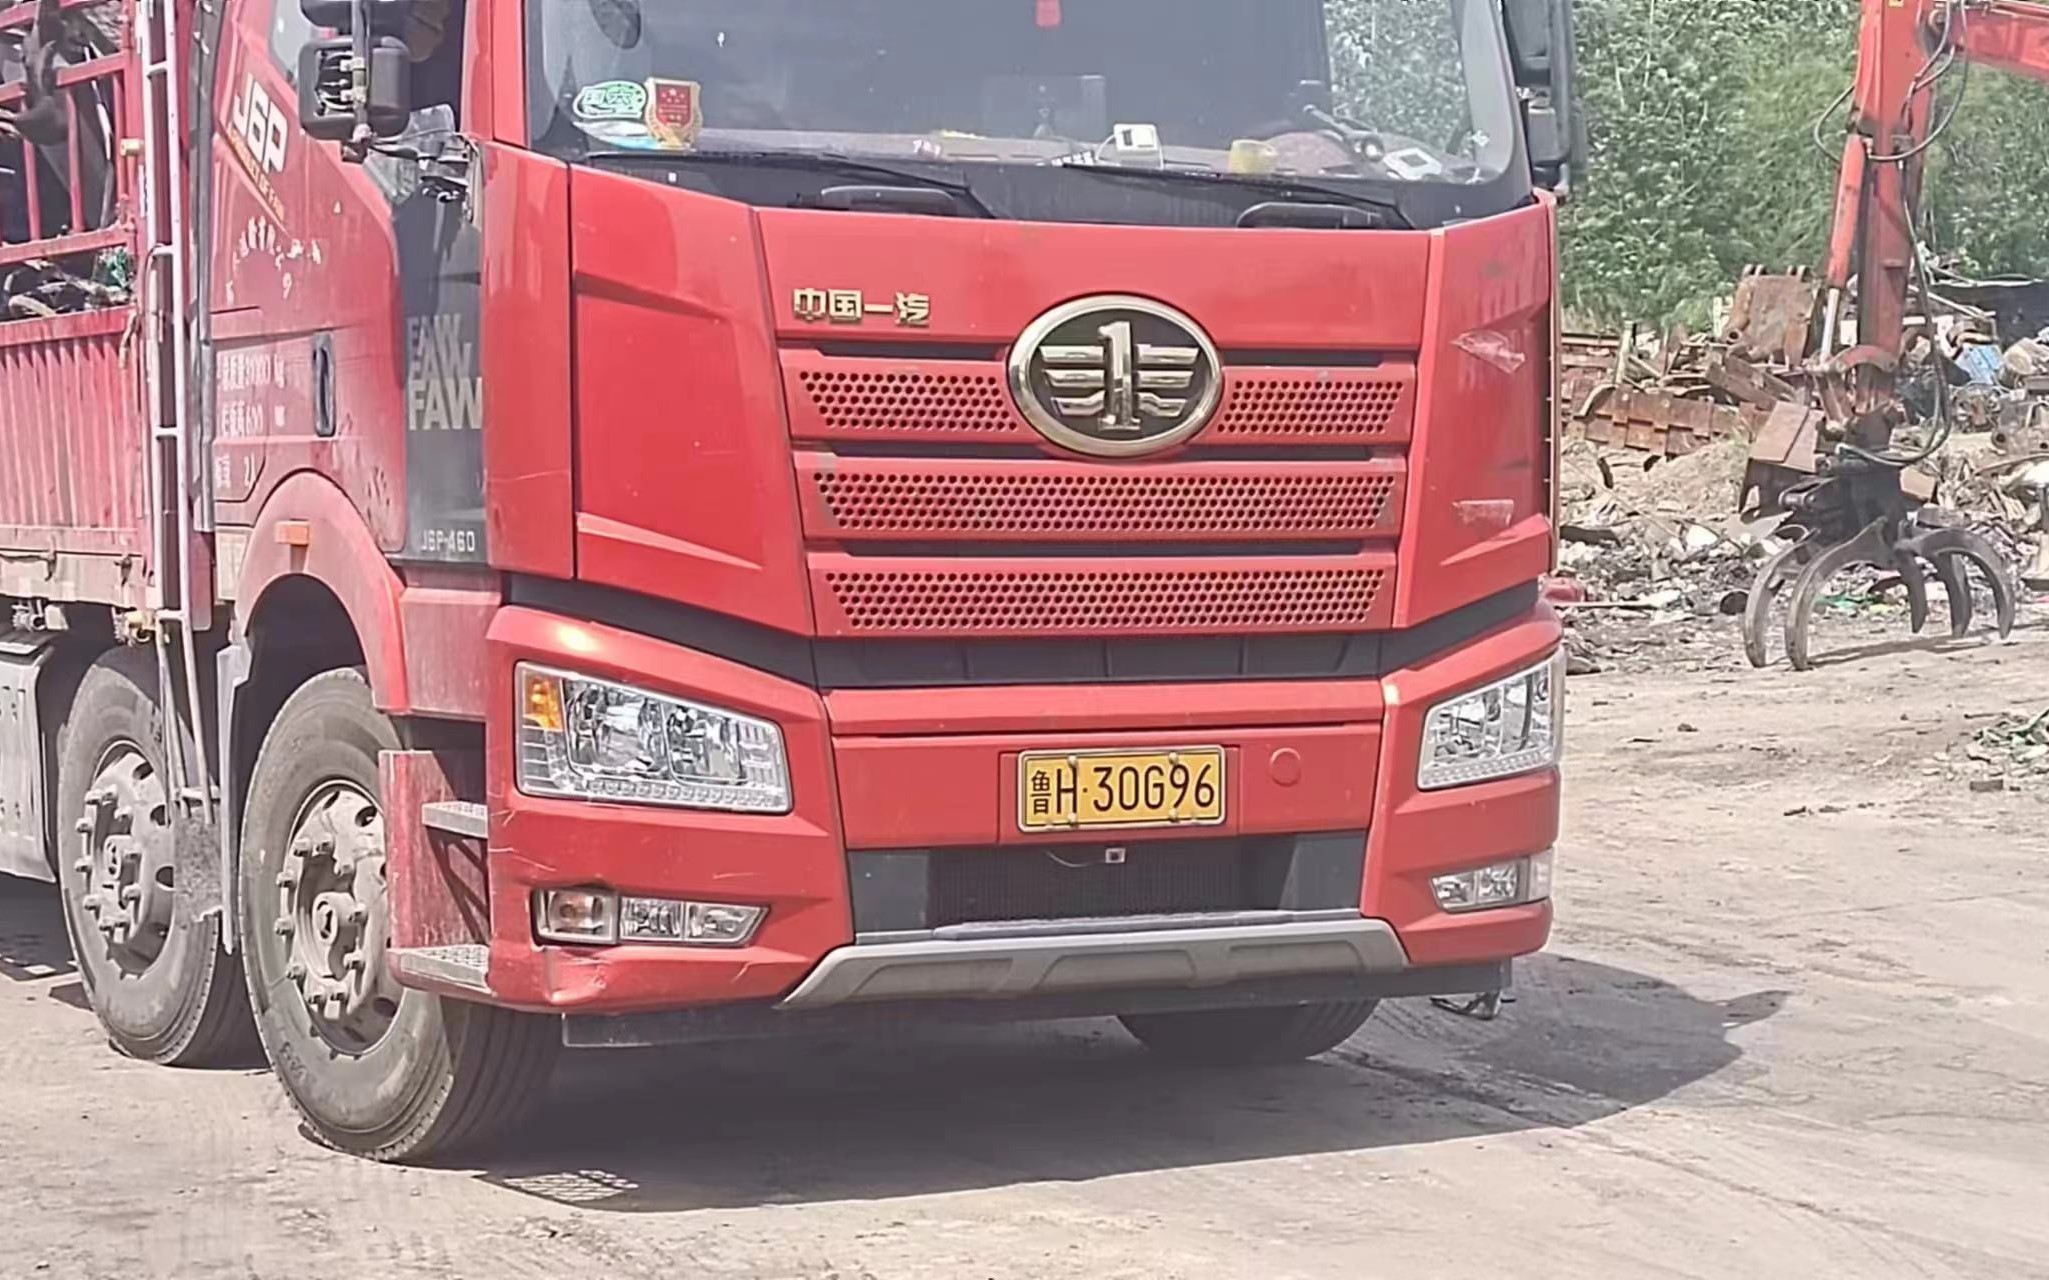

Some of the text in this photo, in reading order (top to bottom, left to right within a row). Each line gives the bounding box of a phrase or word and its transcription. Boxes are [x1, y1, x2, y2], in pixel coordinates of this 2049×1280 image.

[232, 72, 288, 174] J6P
[793, 287, 930, 326] 中国一汽
[408, 376, 482, 430] FAW
[421, 529, 475, 552] J6P-460
[1030, 763, 1216, 816] 鲁H·30G96
